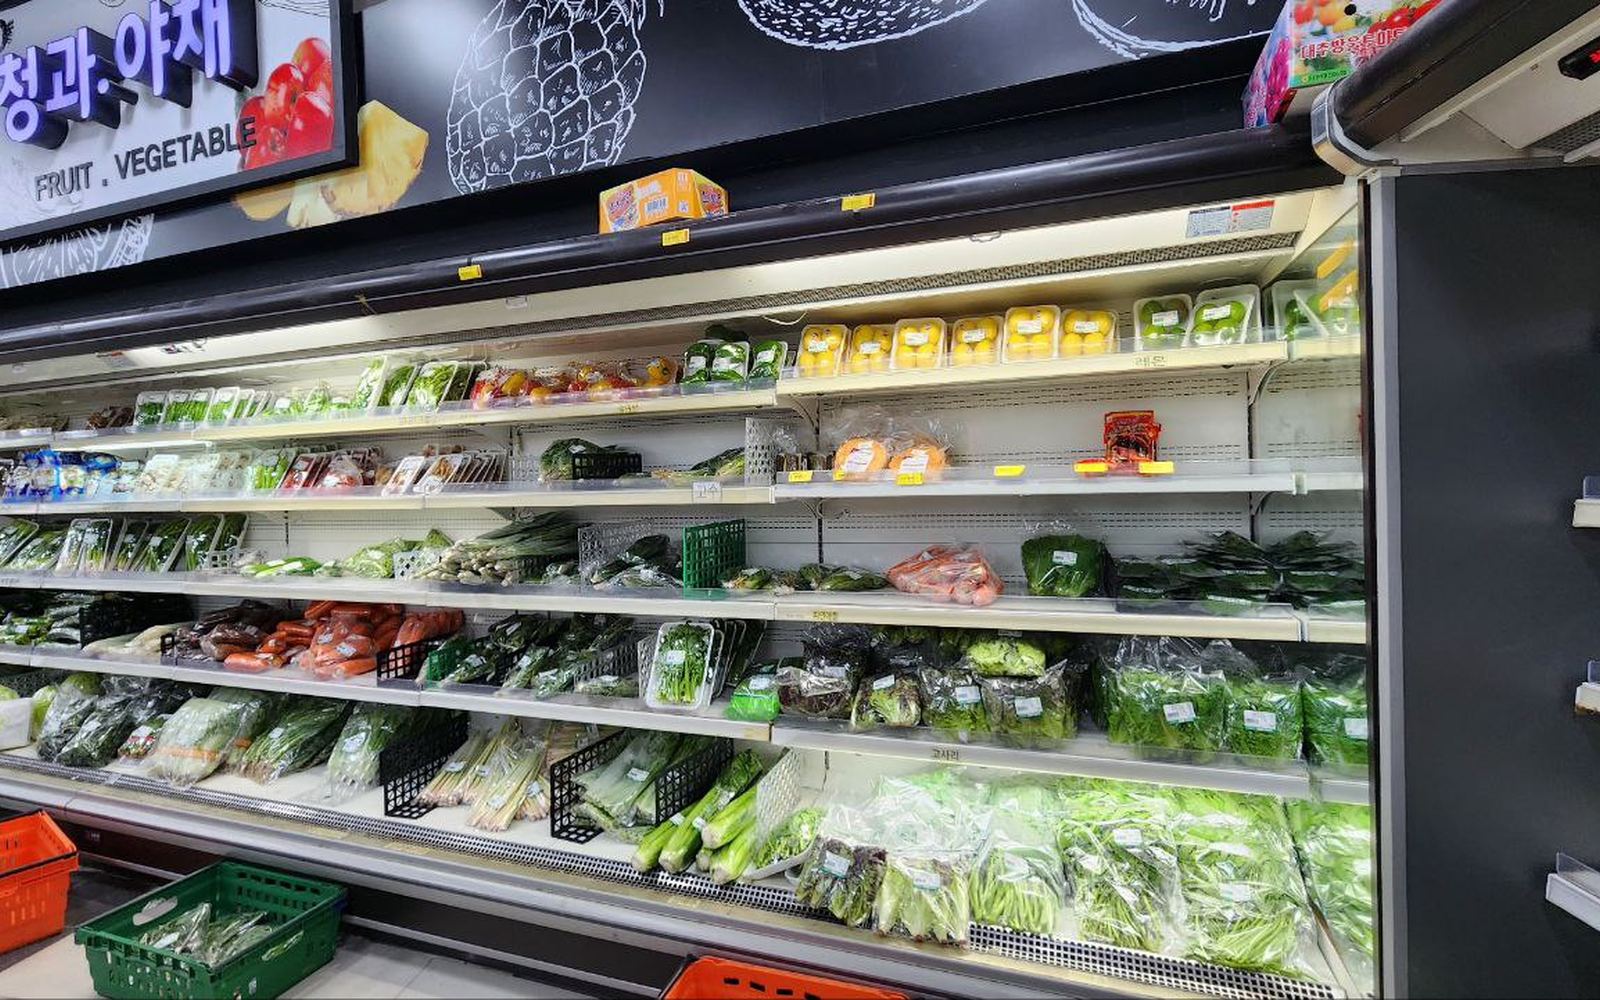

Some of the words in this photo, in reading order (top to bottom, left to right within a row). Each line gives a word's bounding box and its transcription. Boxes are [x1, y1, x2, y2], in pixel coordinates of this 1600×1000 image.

[35, 161, 94, 202] FRUIT
[115, 118, 256, 179] VEGETABLE
[931, 748, 960, 761] 고사리
